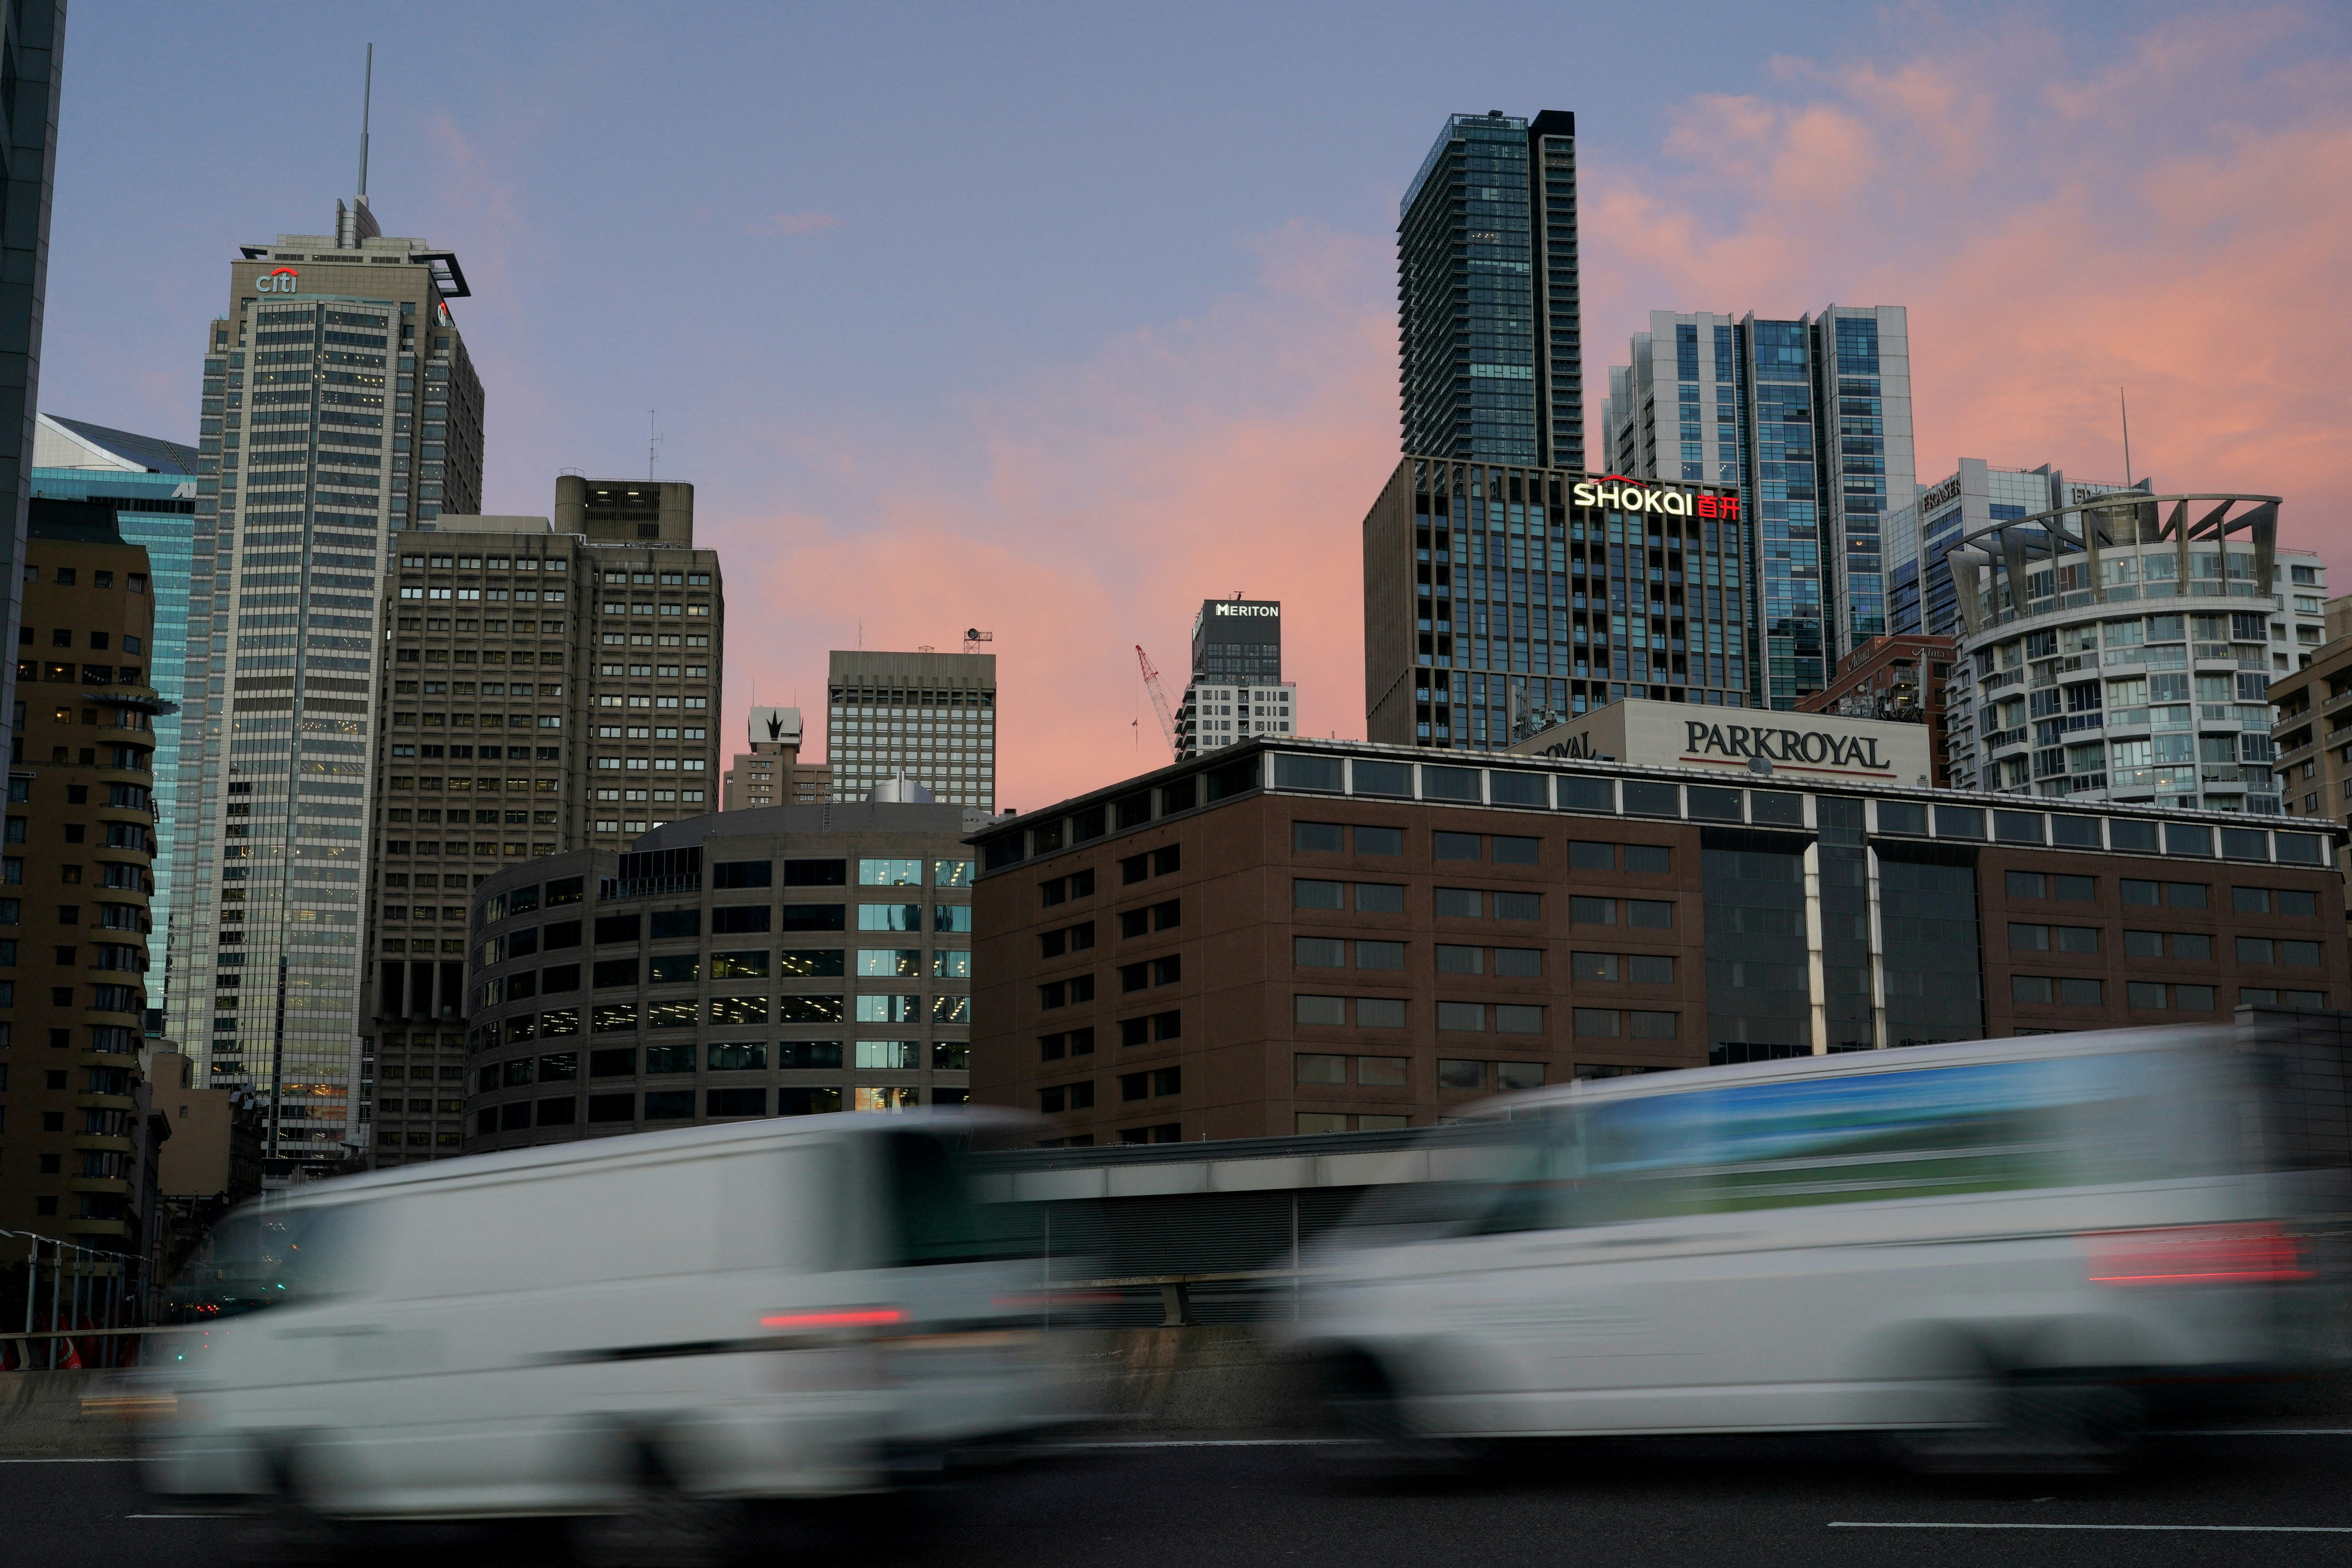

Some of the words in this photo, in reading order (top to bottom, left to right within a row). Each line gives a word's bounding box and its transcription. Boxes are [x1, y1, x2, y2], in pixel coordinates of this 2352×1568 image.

[255, 270, 297, 293] citi
[1696, 494, 1740, 520] 首开
[1216, 603, 1279, 617] MERITON
[1685, 721, 1890, 769] PARKROYAL
